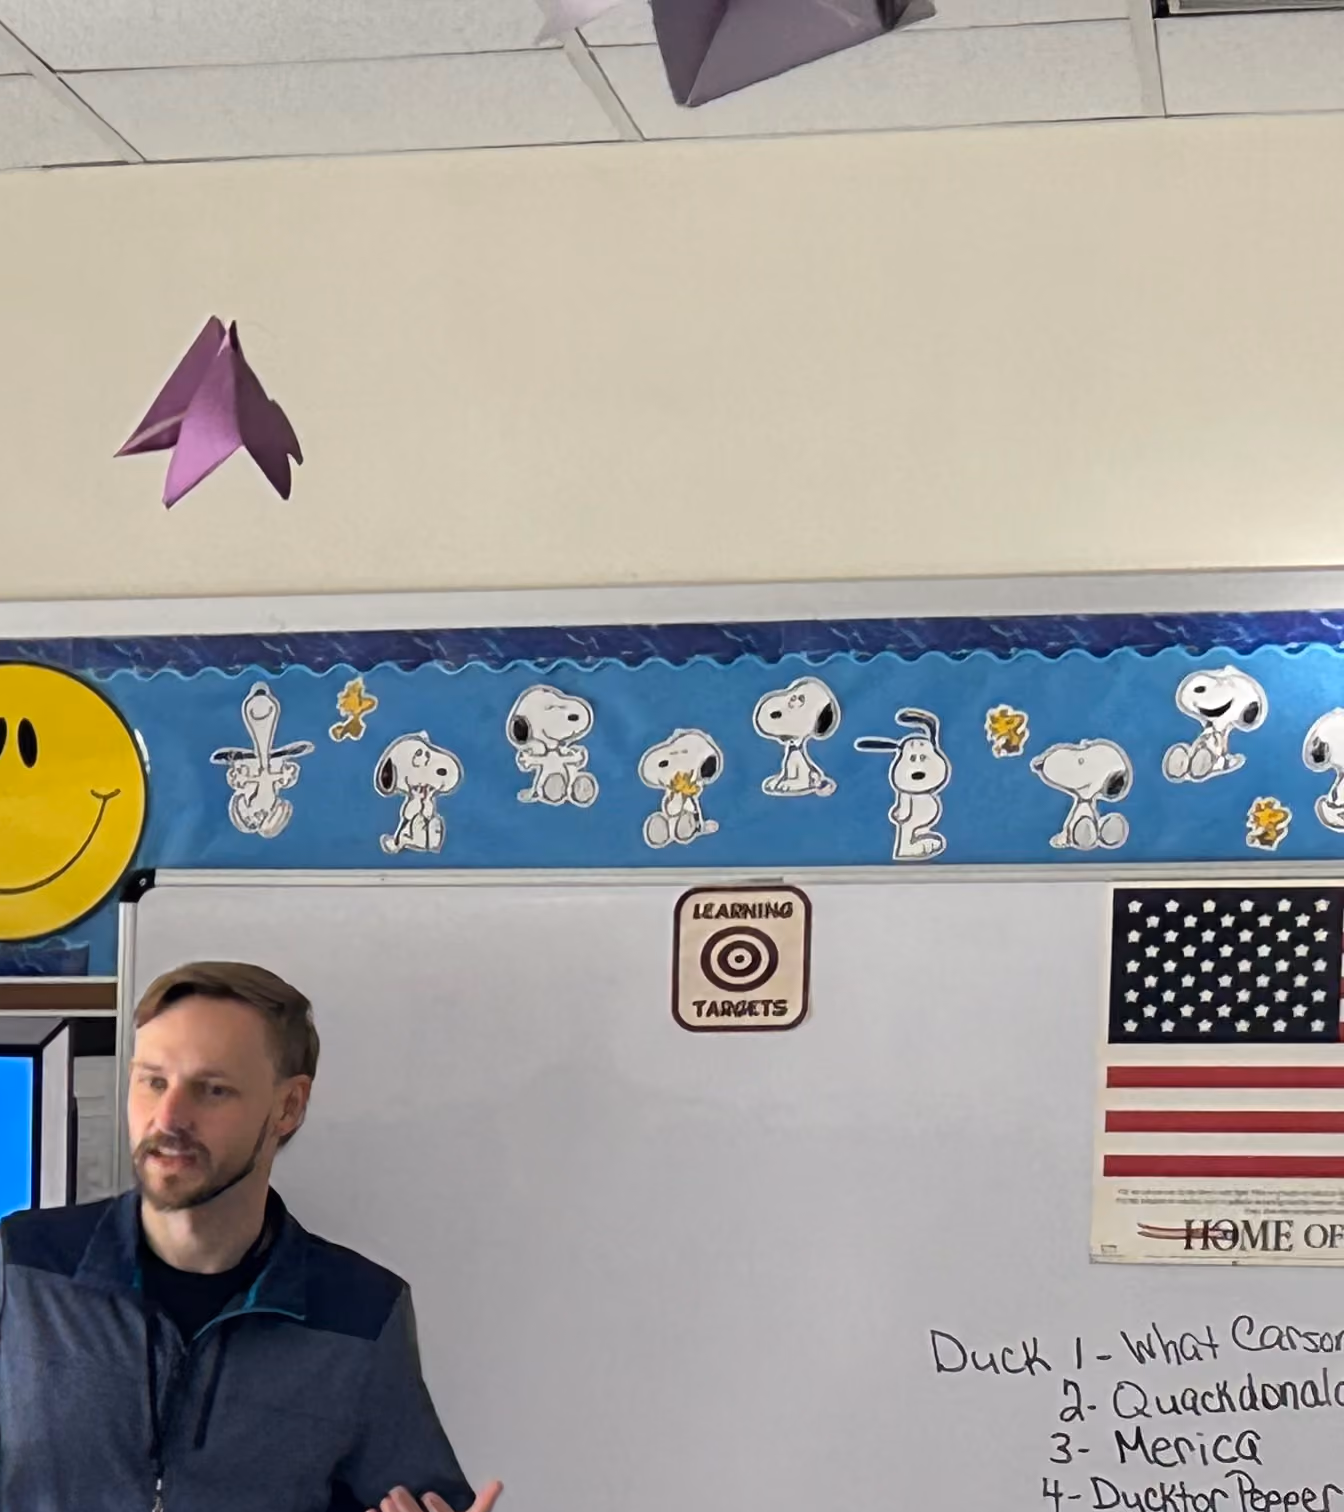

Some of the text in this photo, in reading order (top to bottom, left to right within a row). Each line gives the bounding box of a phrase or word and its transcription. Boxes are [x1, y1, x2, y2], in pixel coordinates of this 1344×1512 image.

[693, 901, 794, 919] LEARNING
[692, 999, 789, 1018] TARGETS
[1184, 1218, 1344, 1252] HOME OF
[930, 1329, 1051, 1376] Duck
[1115, 1426, 1263, 1467] Merica
